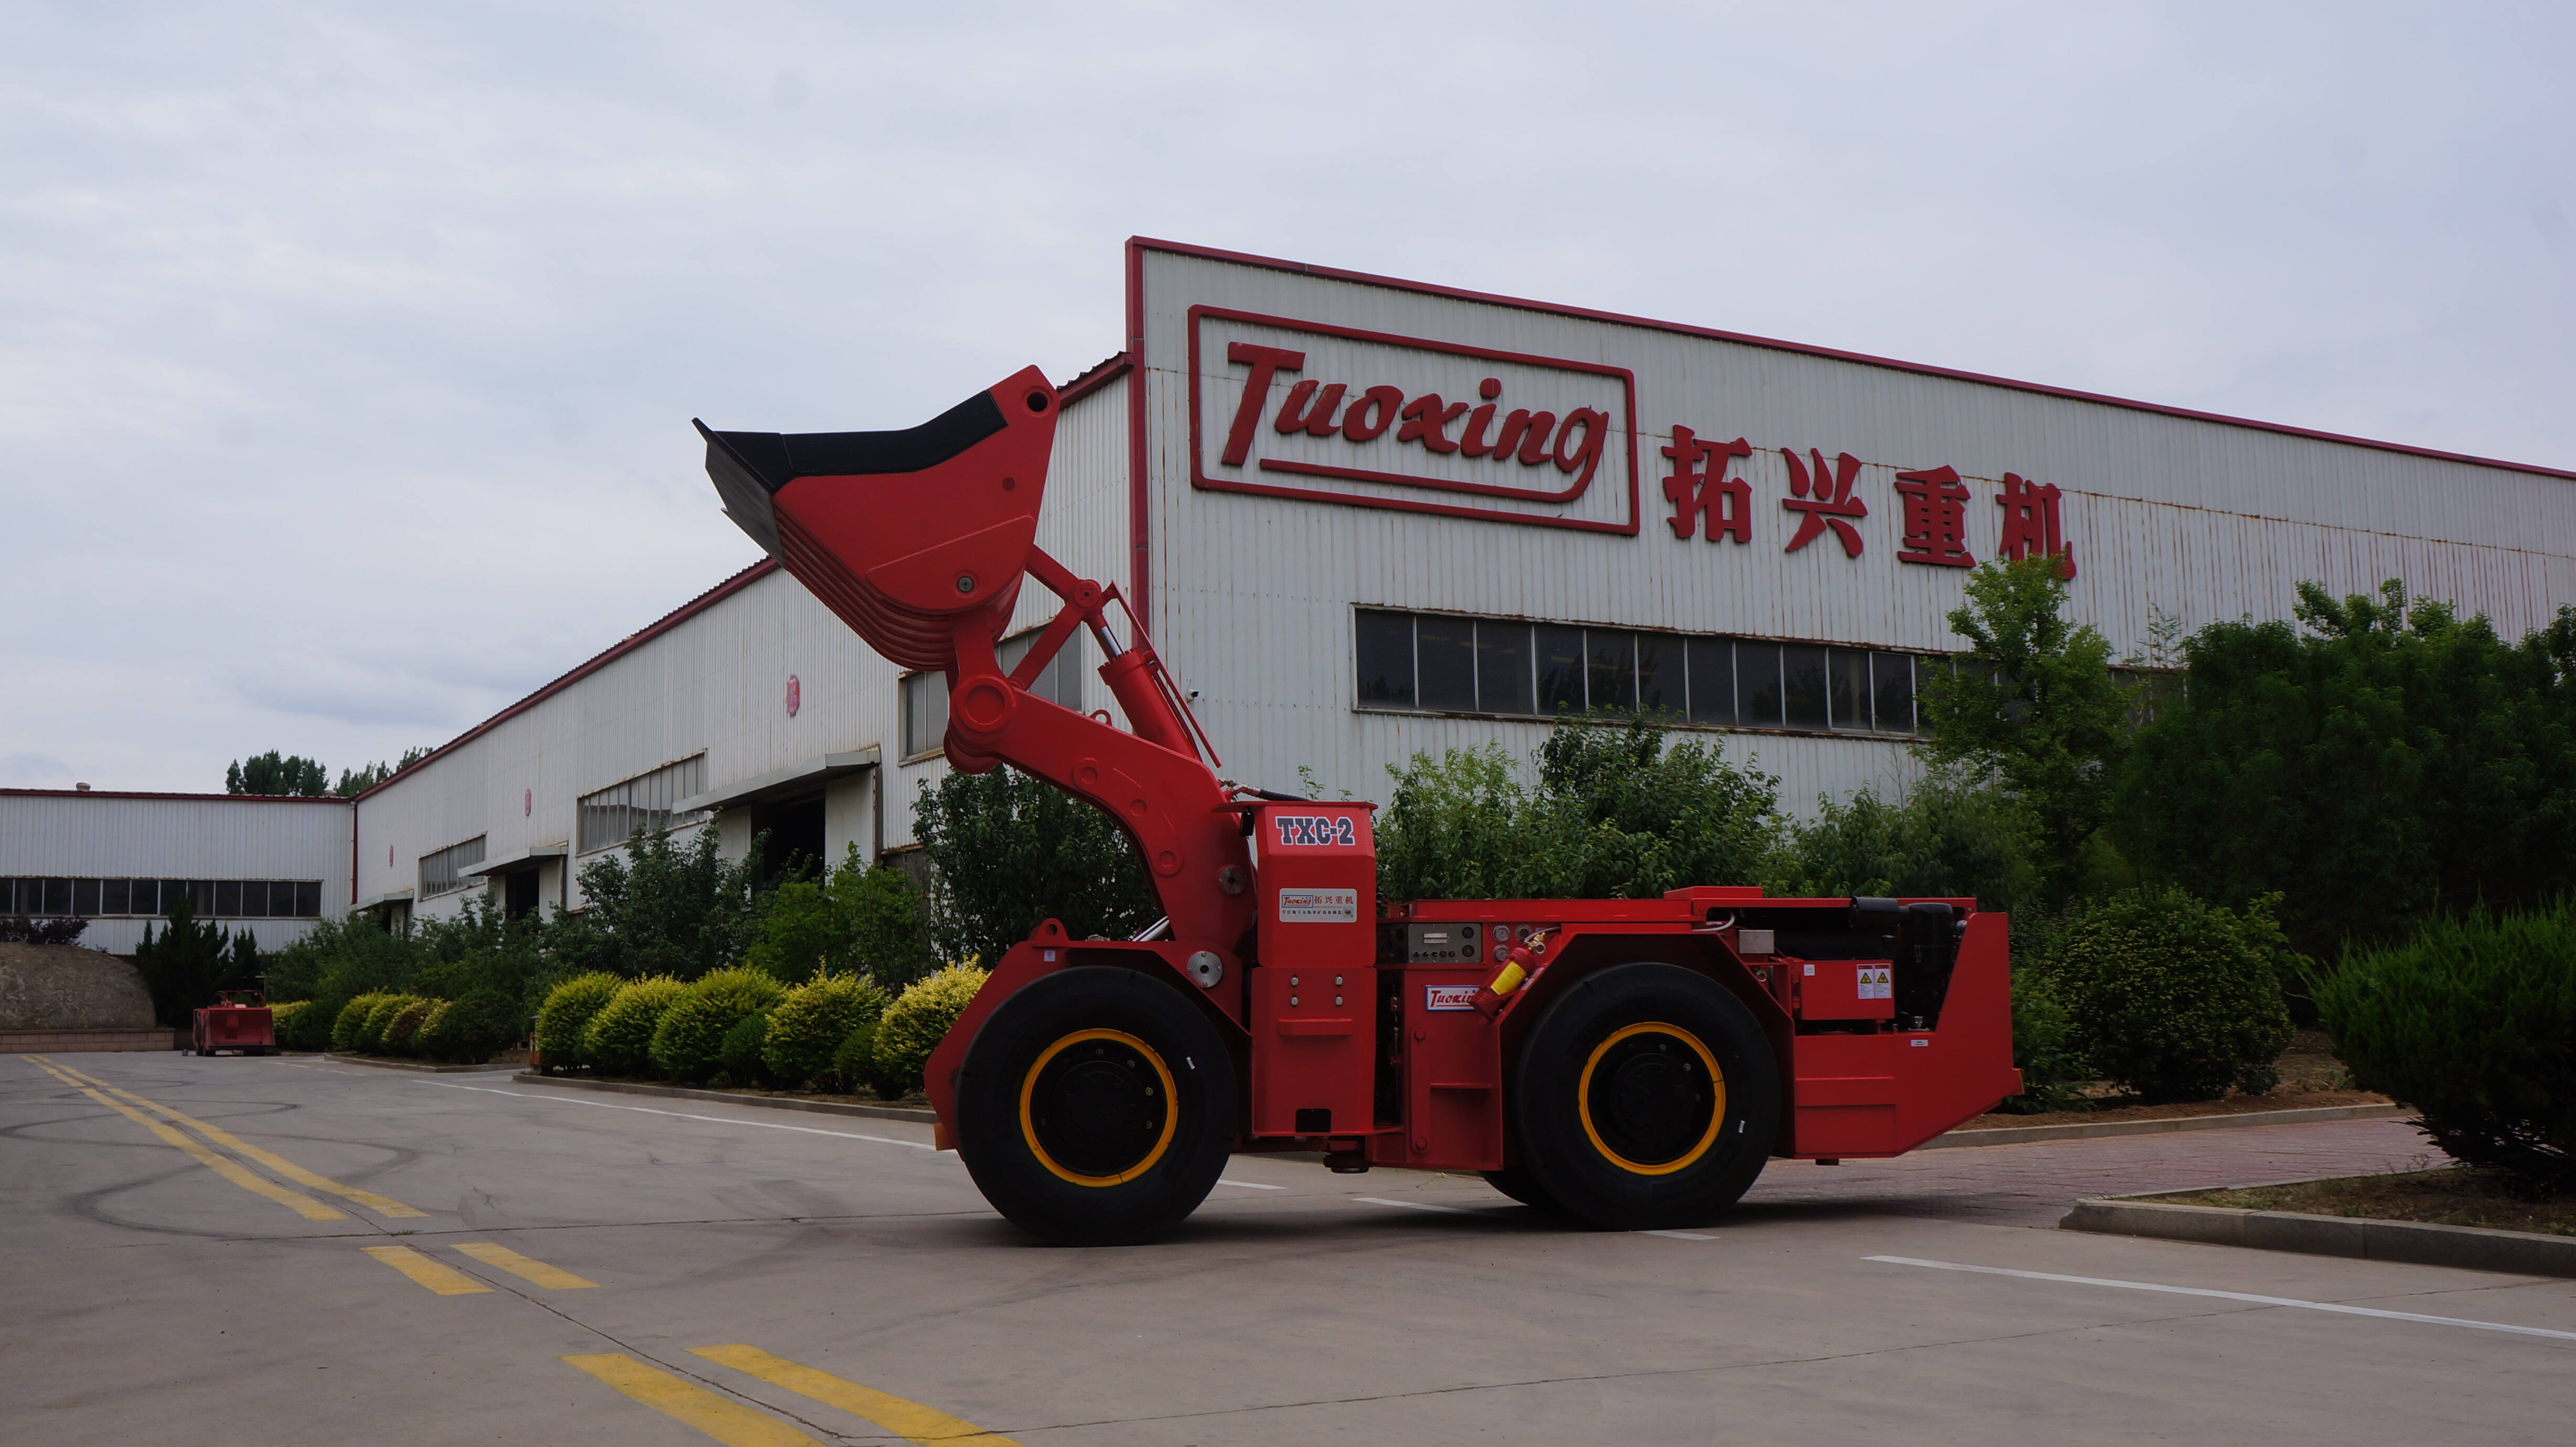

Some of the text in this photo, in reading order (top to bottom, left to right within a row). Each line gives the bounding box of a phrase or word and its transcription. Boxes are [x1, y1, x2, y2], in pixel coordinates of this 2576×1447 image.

[1221, 341, 1609, 504] Tuoxing
[1661, 424, 2077, 580] 拓兴重机
[1275, 816, 1355, 846] TXC-2
[1284, 897, 1311, 906] Tuoxing
[1314, 895, 1354, 904] 拓兴重机
